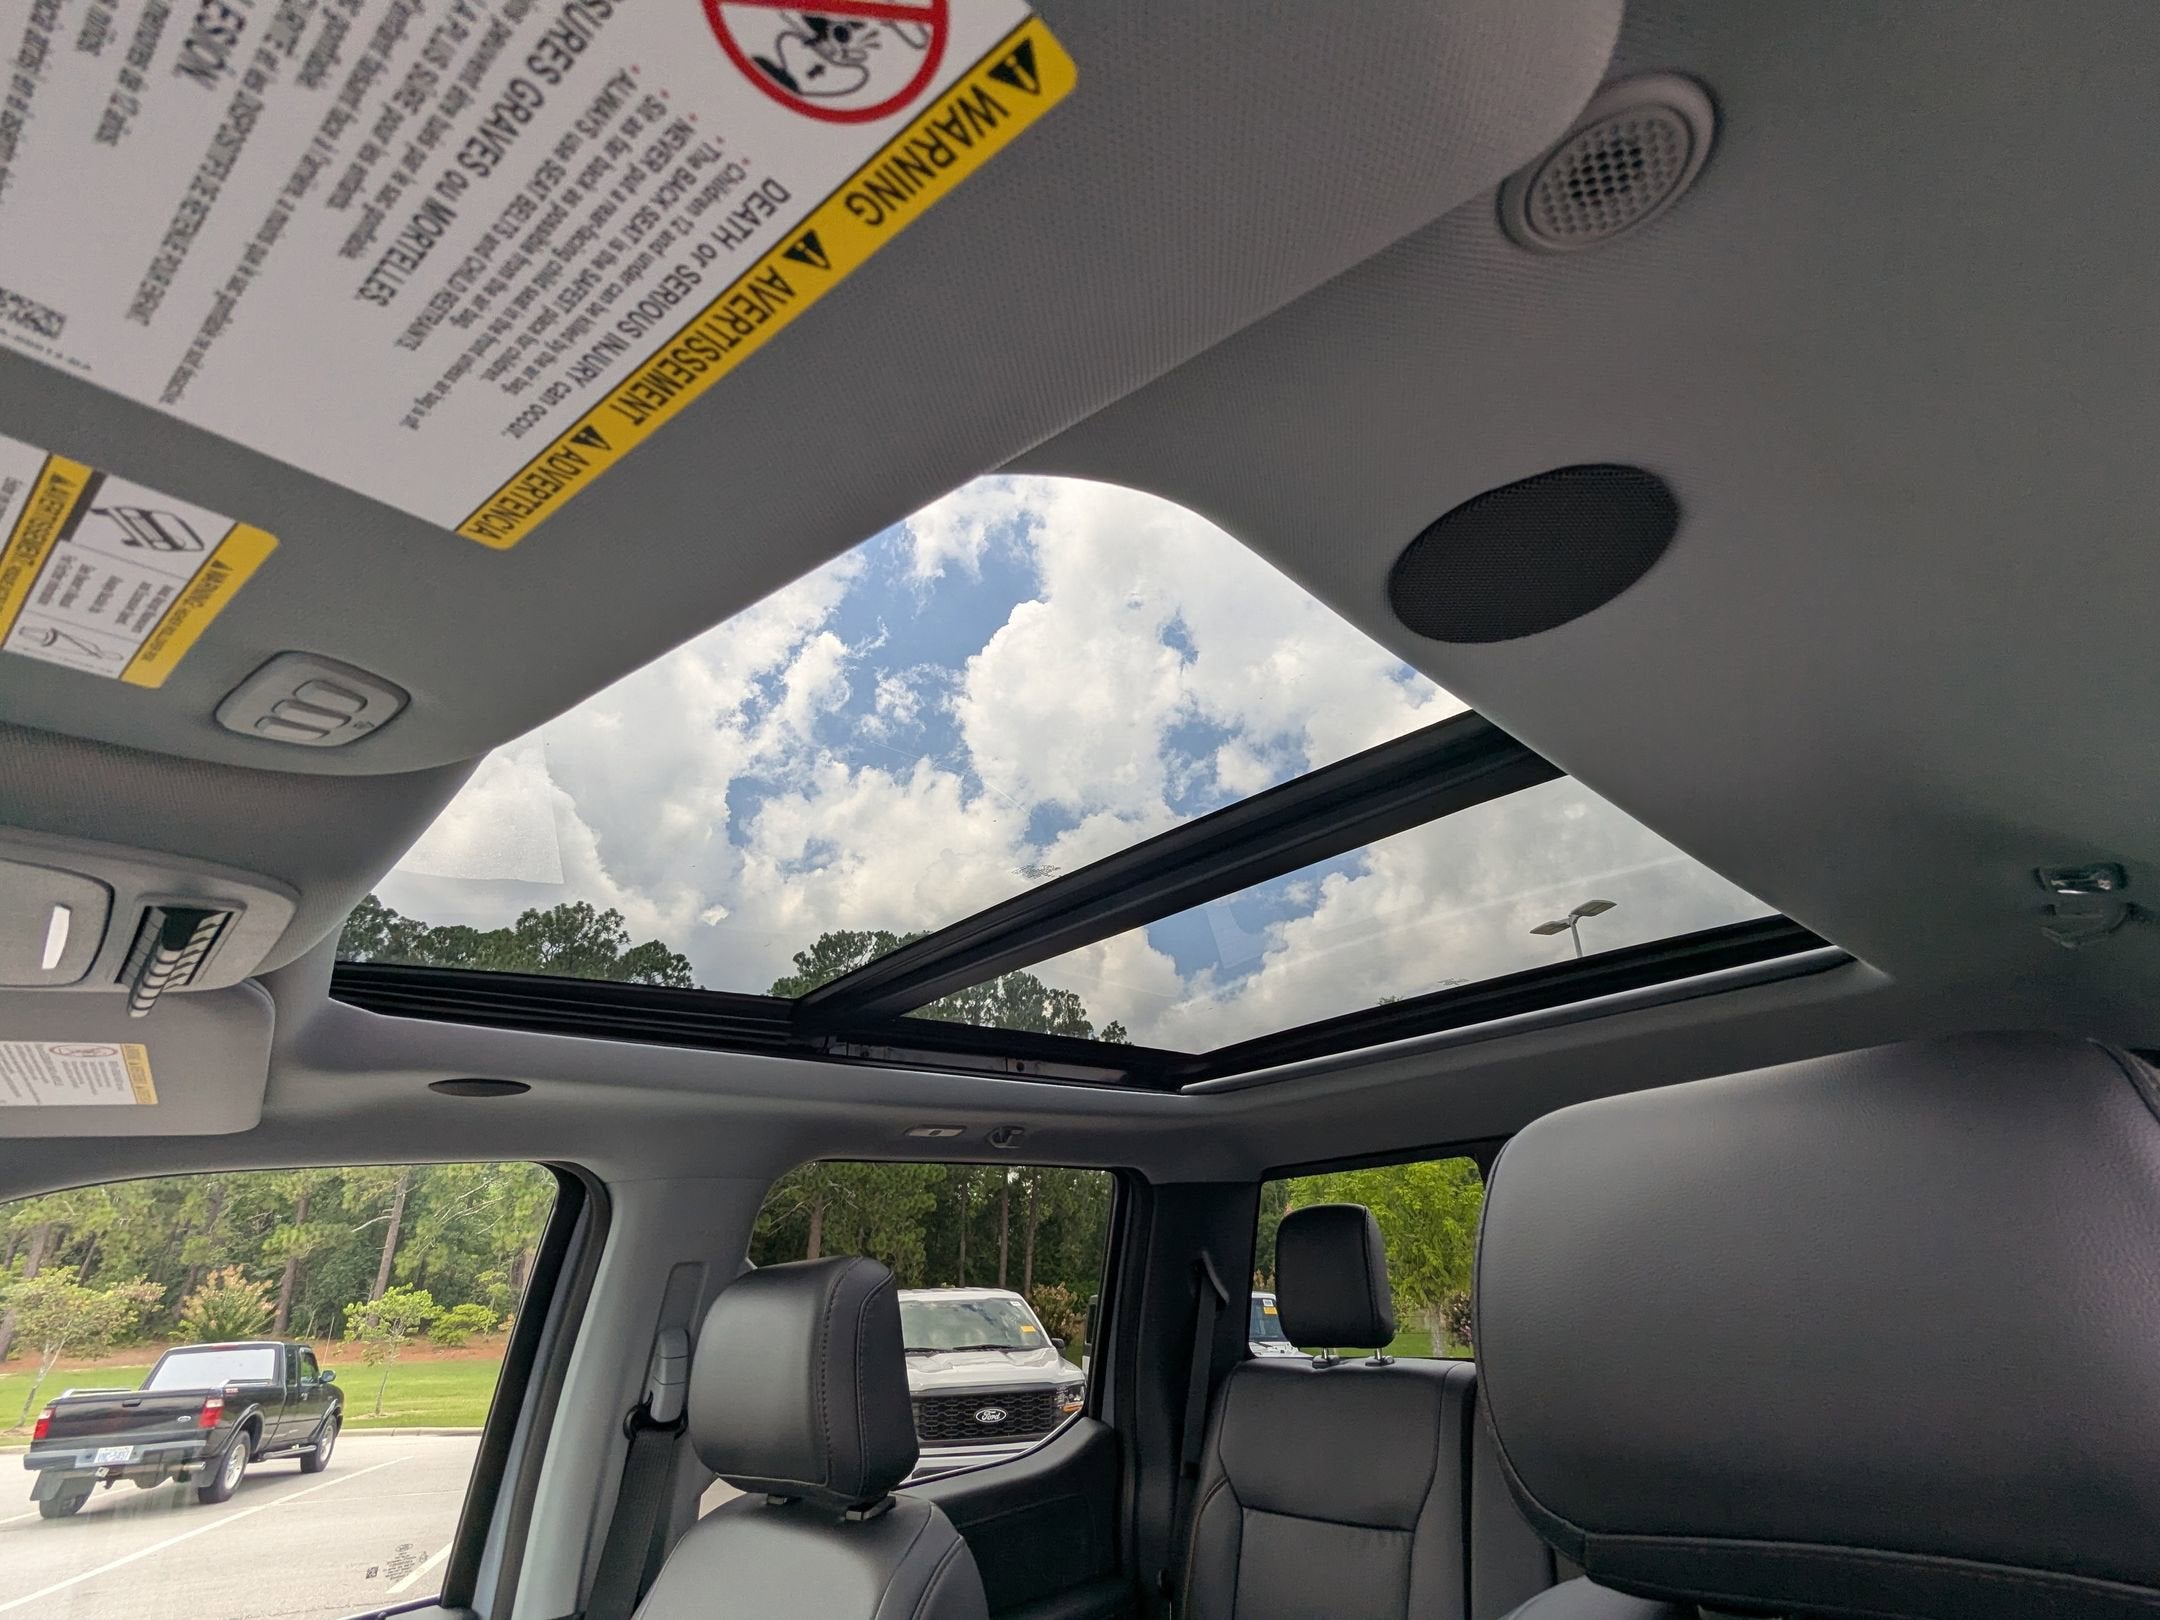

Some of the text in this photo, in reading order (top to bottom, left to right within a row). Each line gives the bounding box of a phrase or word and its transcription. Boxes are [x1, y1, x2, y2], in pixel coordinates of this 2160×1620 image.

[421, 14, 470, 70] PLUS
[457, 14, 514, 91] peuvent
[391, 61, 439, 116] SÛRE
[574, 68, 637, 139] ALWAYS
[318, 105, 358, 141] face
[371, 102, 406, 146] pour
[635, 94, 667, 123] Sit
[456, 77, 545, 178] GRAVES
[356, 140, 389, 166] les
[400, 141, 428, 175] par
[553, 131, 583, 163] use
[603, 134, 633, 161] far
[639, 118, 695, 174] NEVER
[685, 142, 723, 171] The
[433, 169, 470, 202] ou
[526, 158, 567, 202] SEAT
[574, 155, 616, 192] back
[618, 162, 647, 195] put
[650, 166, 697, 212] BACK
[685, 162, 747, 217] Children
[373, 182, 402, 210] sac
[491, 193, 539, 240] BELTS
[519, 200, 569, 255] possible
[551, 199, 618, 263] rear-facing
[621, 204, 661, 245] SEAT
[355, 197, 458, 307] MORTELLES.
[473, 232, 501, 262] and
[647, 229, 677, 258] and
[446, 255, 487, 293] CHILD
[497, 252, 533, 281] from
[531, 259, 564, 292] child
[618, 251, 655, 287] under
[501, 177, 791, 440] DEATH or SERIOUS INJURY can occur.
[511, 285, 540, 311] seat
[552, 268, 603, 315] SAFEST
[467, 84, 1010, 540] WARNING AVERTISSEMENT ADVERTENCIA
[526, 304, 559, 336] place
[559, 314, 597, 345] killed
[467, 332, 501, 358] front
[443, 353, 476, 384] unless
